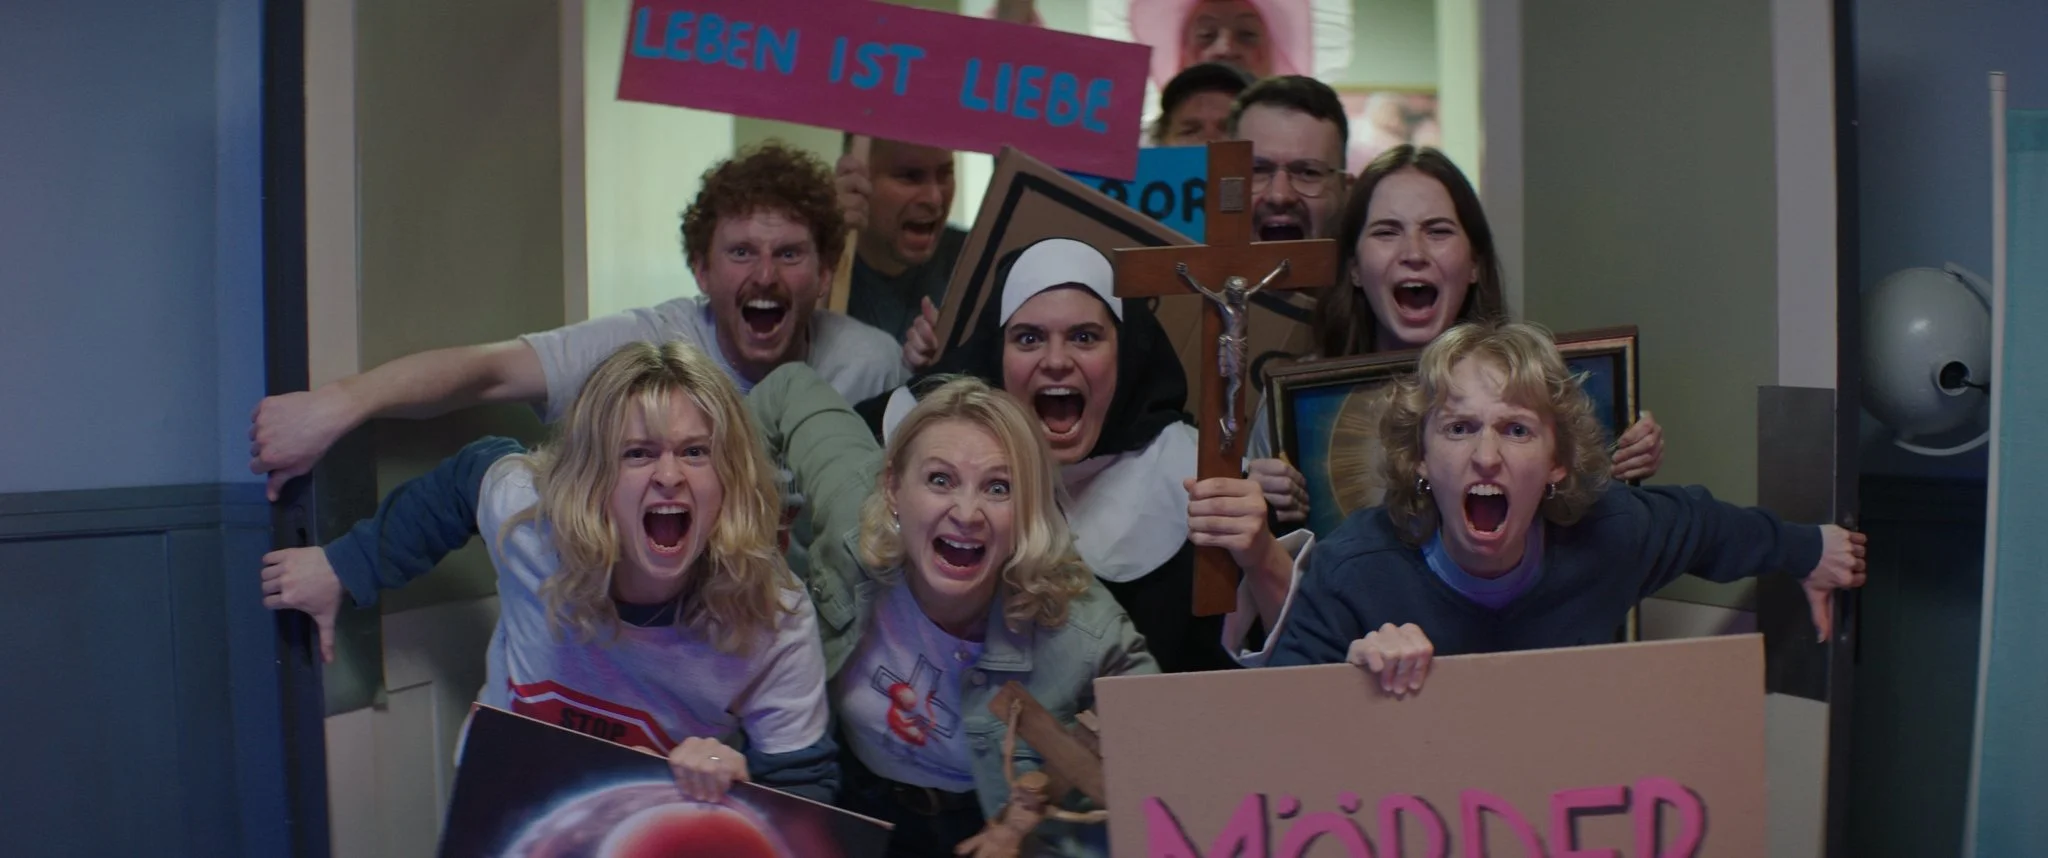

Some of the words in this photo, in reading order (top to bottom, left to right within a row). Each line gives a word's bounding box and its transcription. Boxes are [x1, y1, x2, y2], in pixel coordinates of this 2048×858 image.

[632, 7, 798, 75] LEBEN
[828, 37, 925, 95] IST
[960, 58, 1114, 133] LIEBE
[561, 707, 627, 740] STOP
